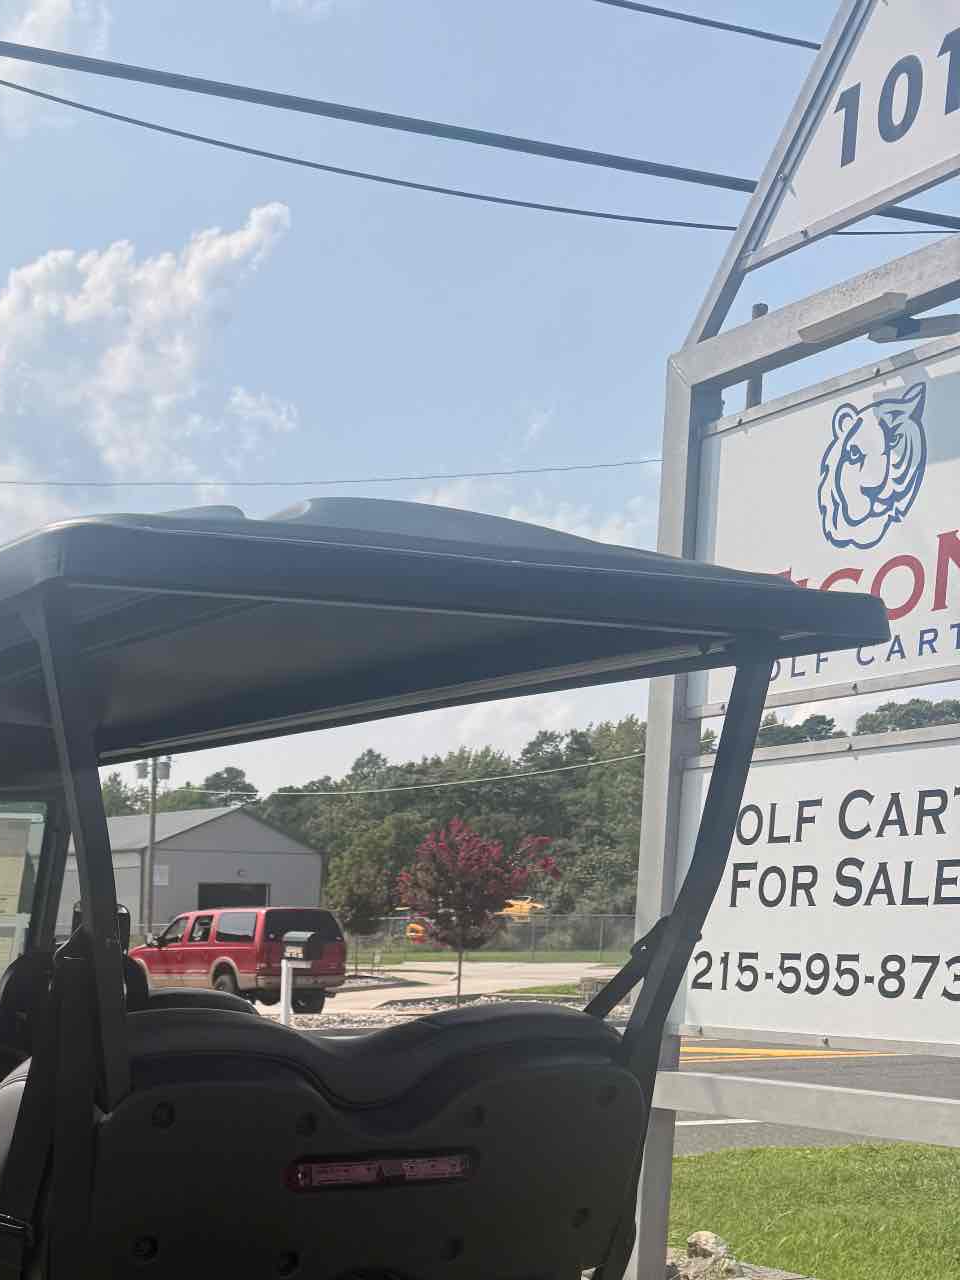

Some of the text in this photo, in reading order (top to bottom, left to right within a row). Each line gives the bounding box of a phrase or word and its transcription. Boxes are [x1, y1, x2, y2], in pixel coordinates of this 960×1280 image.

[736, 786, 960, 846] OLF CAR
[728, 856, 960, 908] FOR SALE
